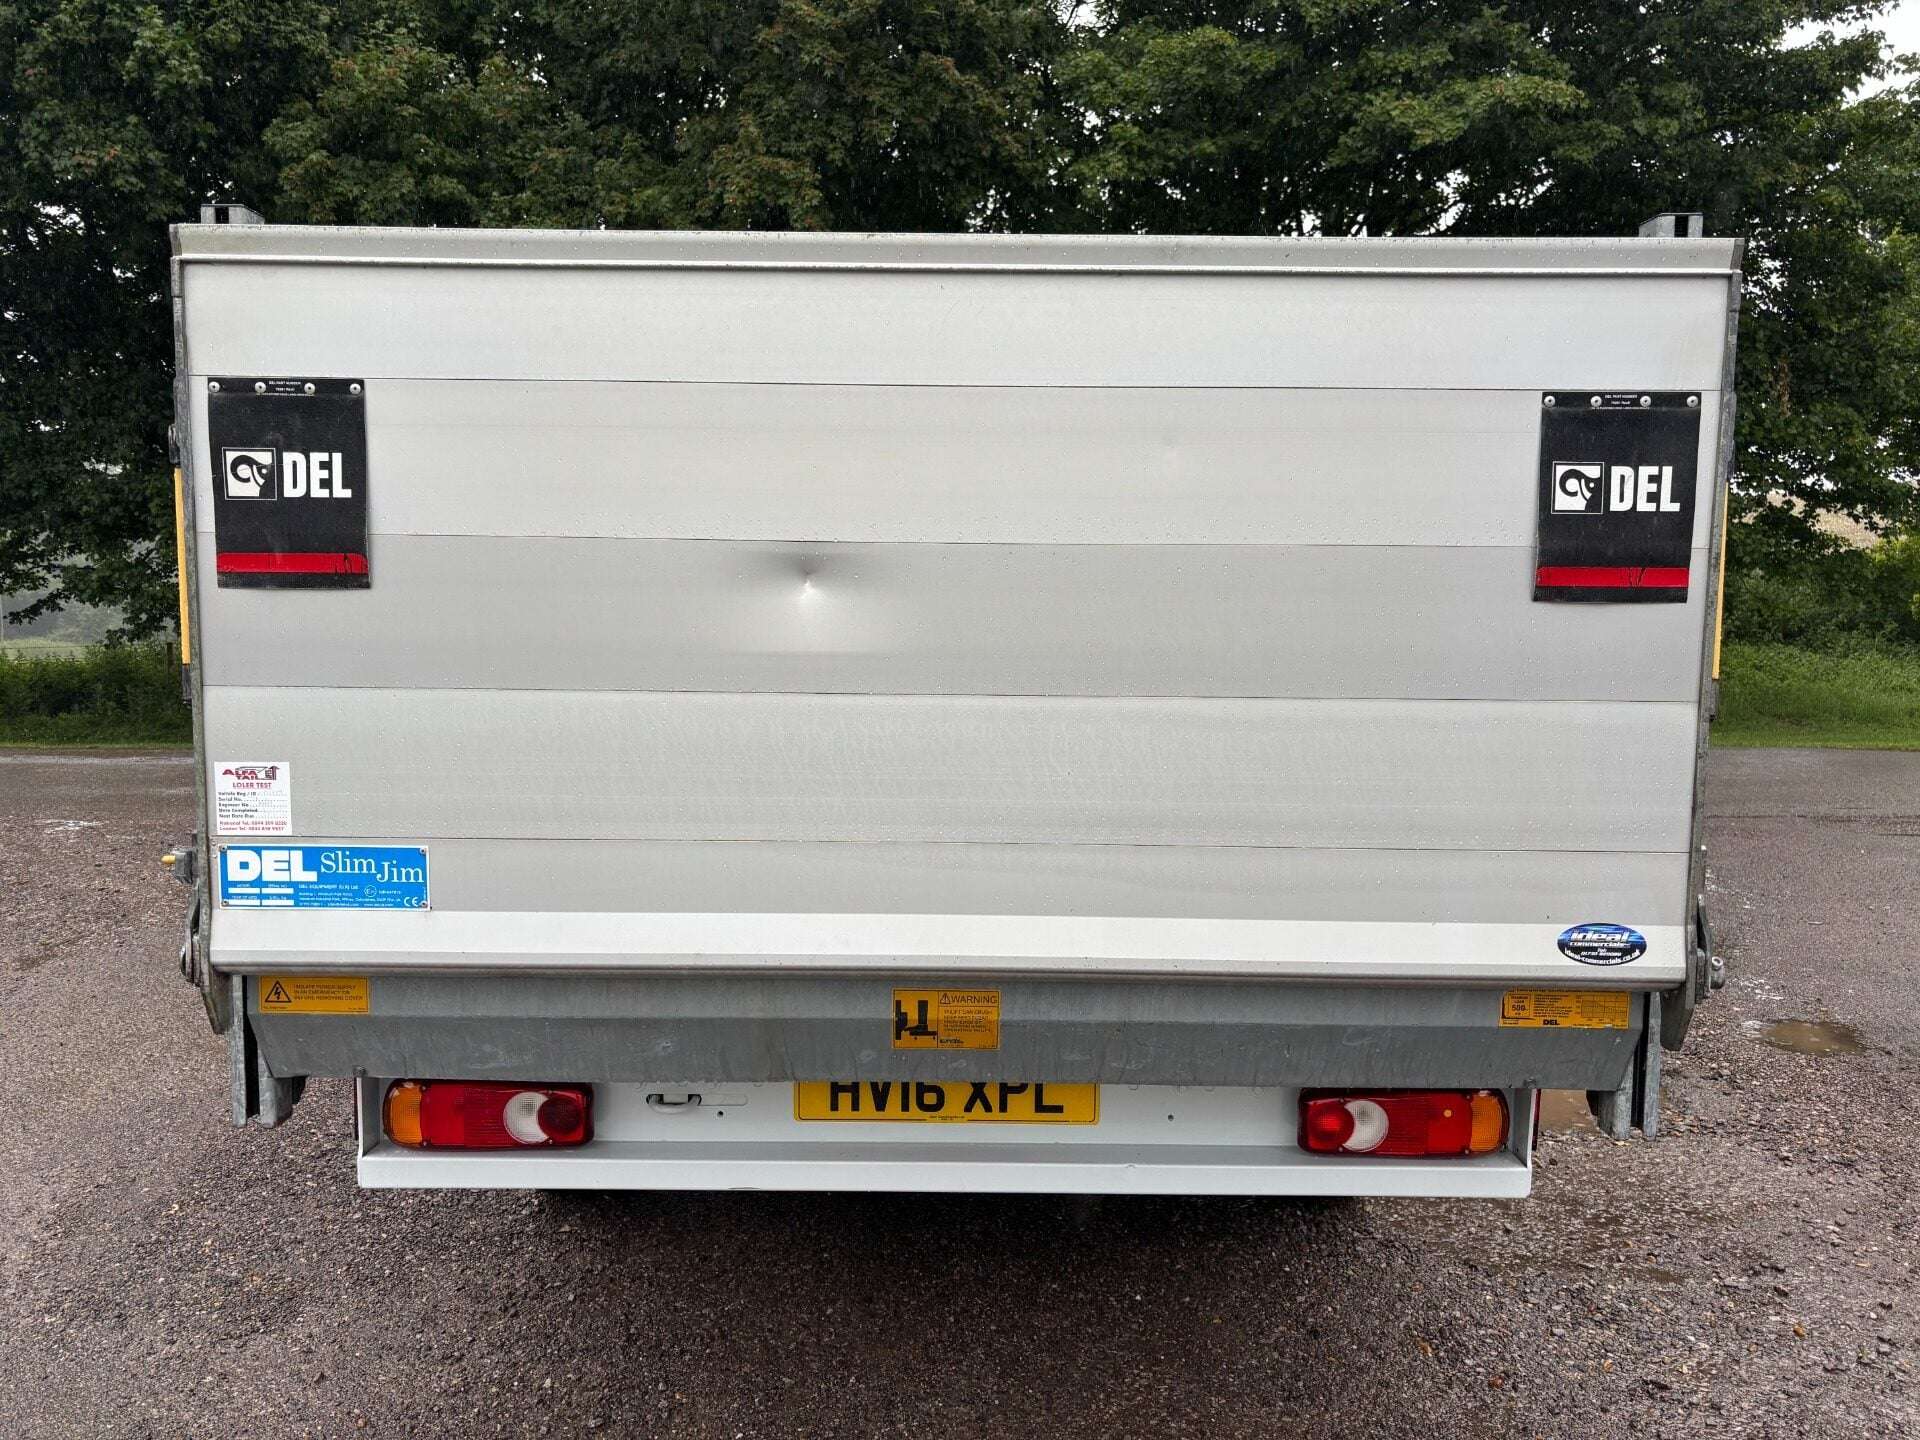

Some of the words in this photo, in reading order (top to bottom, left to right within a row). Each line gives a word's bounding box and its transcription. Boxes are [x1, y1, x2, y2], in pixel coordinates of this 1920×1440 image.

[282, 451, 352, 498] DEL
[1609, 465, 1680, 512] DEL
[226, 850, 318, 882] DEL
[320, 850, 377, 874] Slim
[376, 860, 424, 883] Jim
[1570, 930, 1630, 942] ideal
[951, 995, 998, 1004] WARNING
[830, 1081, 945, 1113] HV16
[963, 1081, 1064, 1114] XPL
